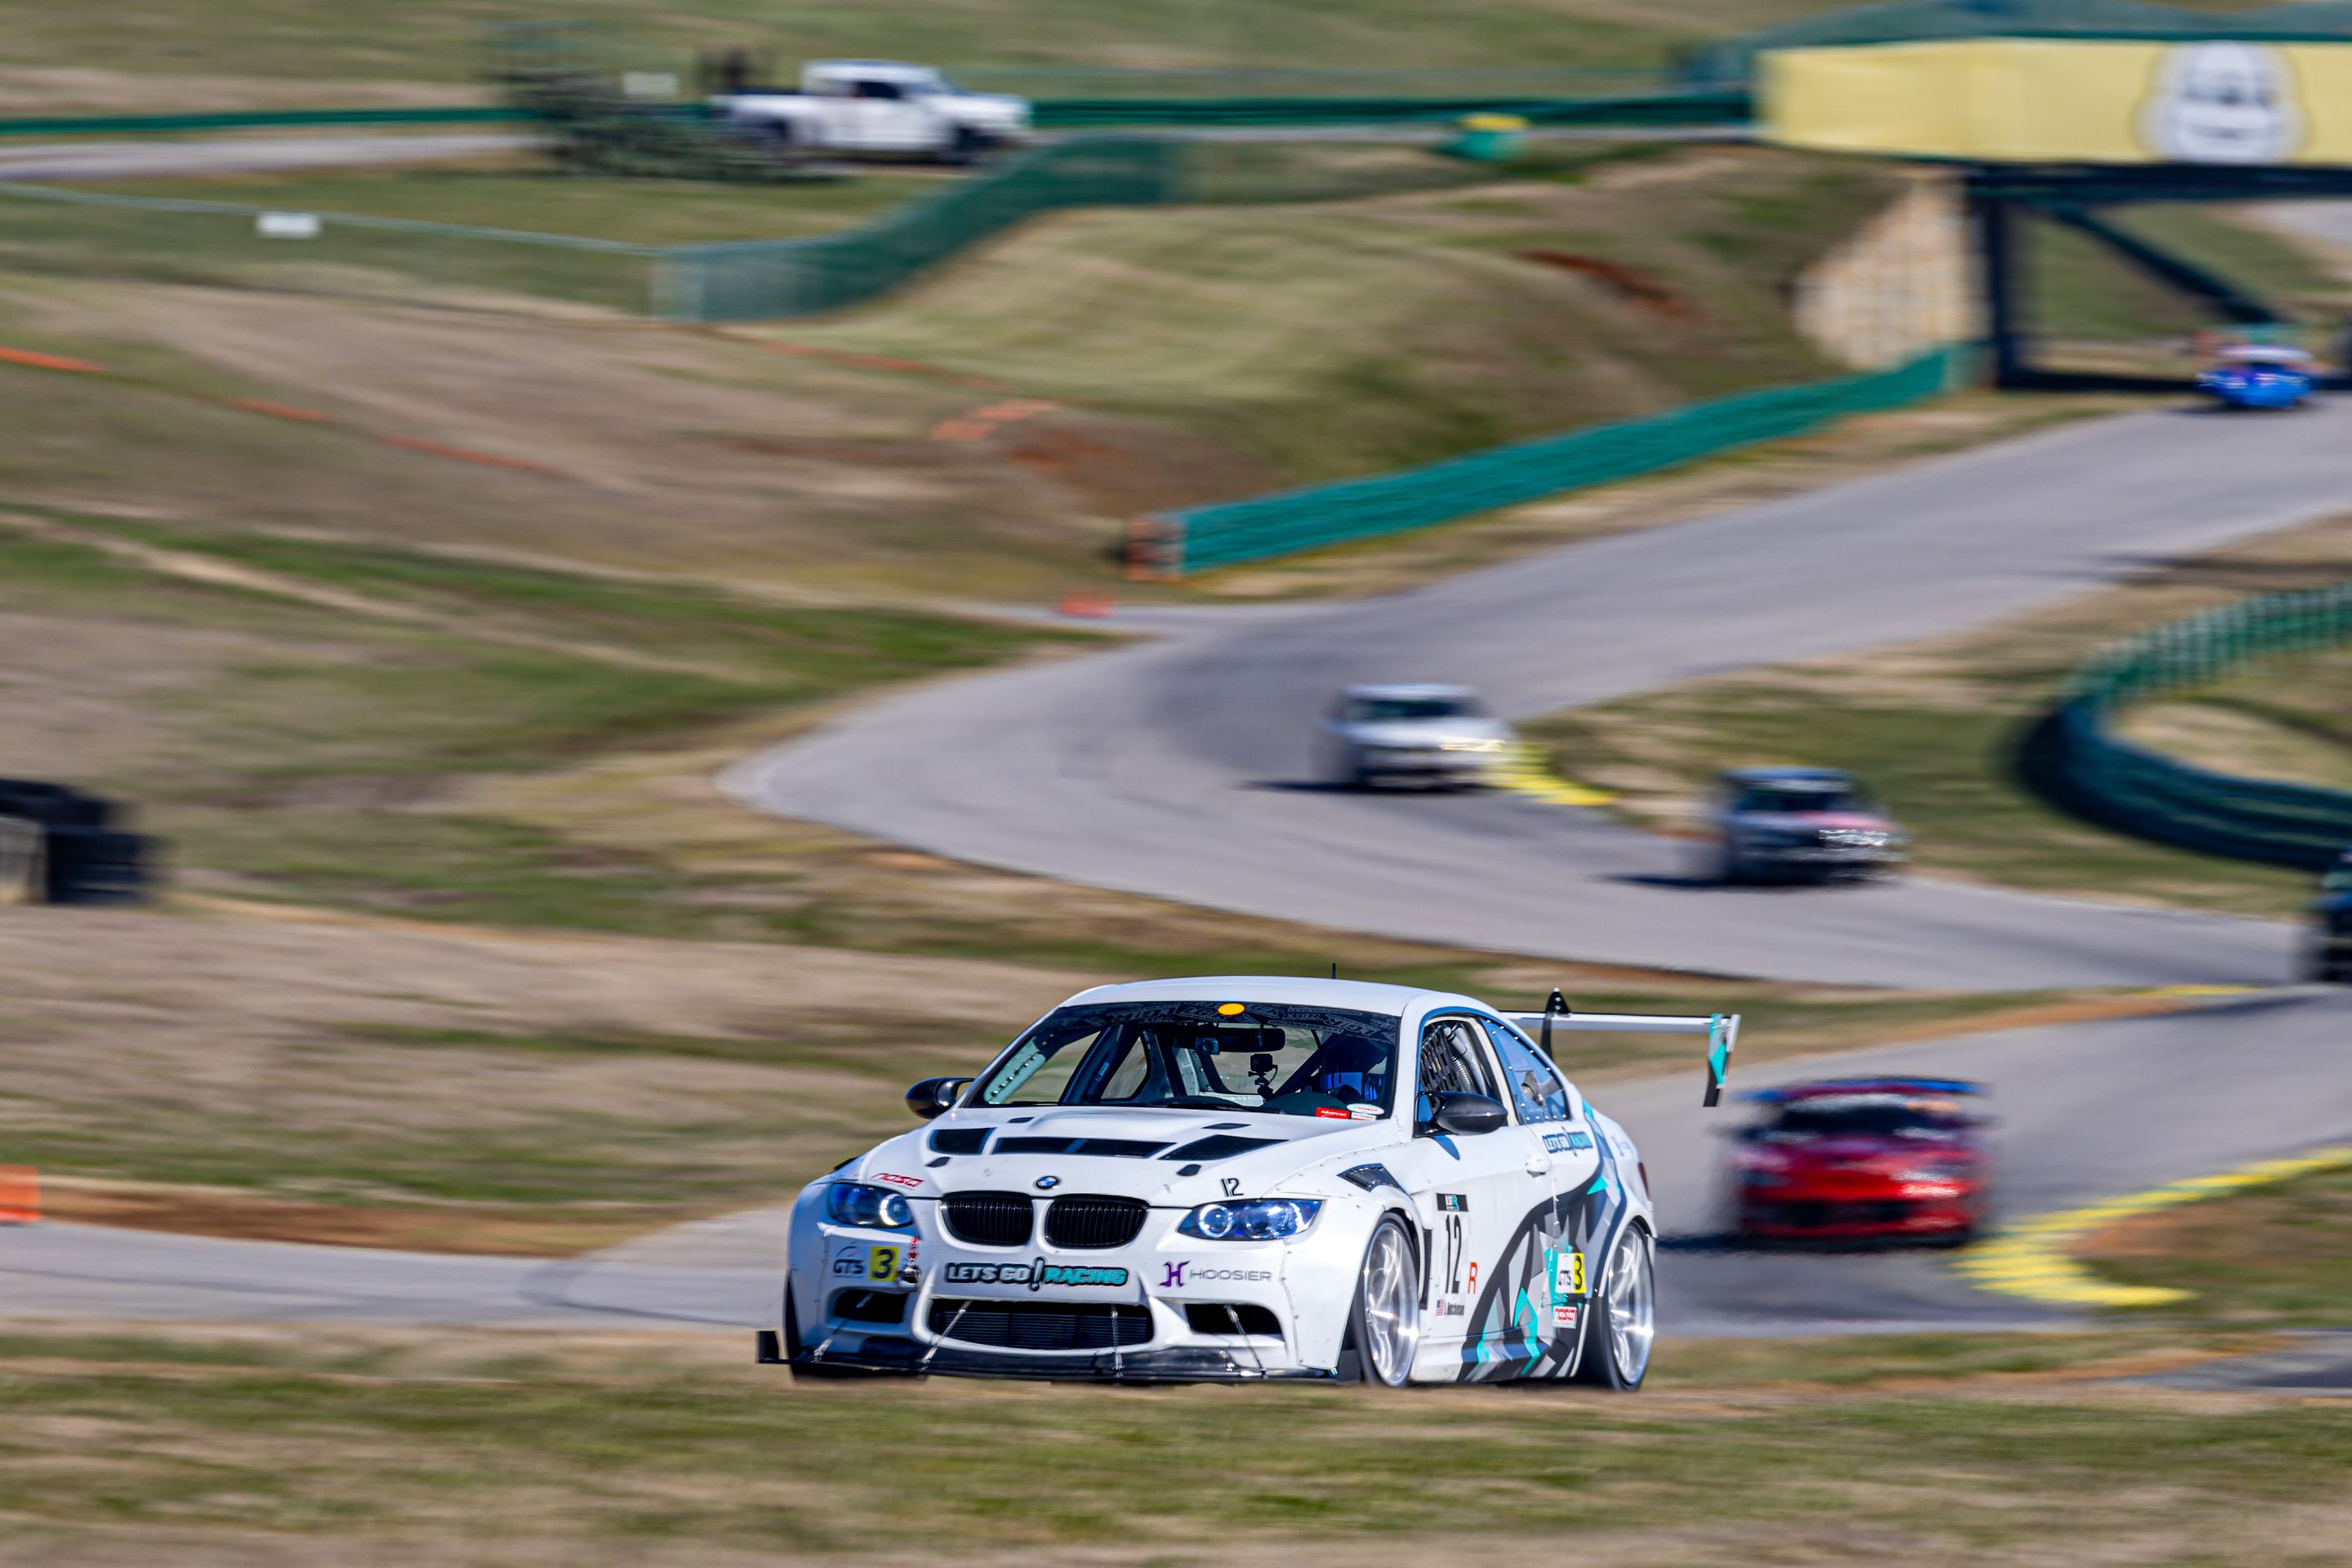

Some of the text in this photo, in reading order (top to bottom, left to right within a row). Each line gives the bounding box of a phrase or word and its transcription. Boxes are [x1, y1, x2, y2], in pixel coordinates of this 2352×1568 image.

[1220, 1178, 1244, 1197] 12
[871, 1249, 894, 1279] 3
[1445, 1214, 1462, 1294] 12
[1468, 1262, 1477, 1294] R
[1190, 1269, 1272, 1281] HOOSIER
[1574, 1255, 1583, 1290] 3
